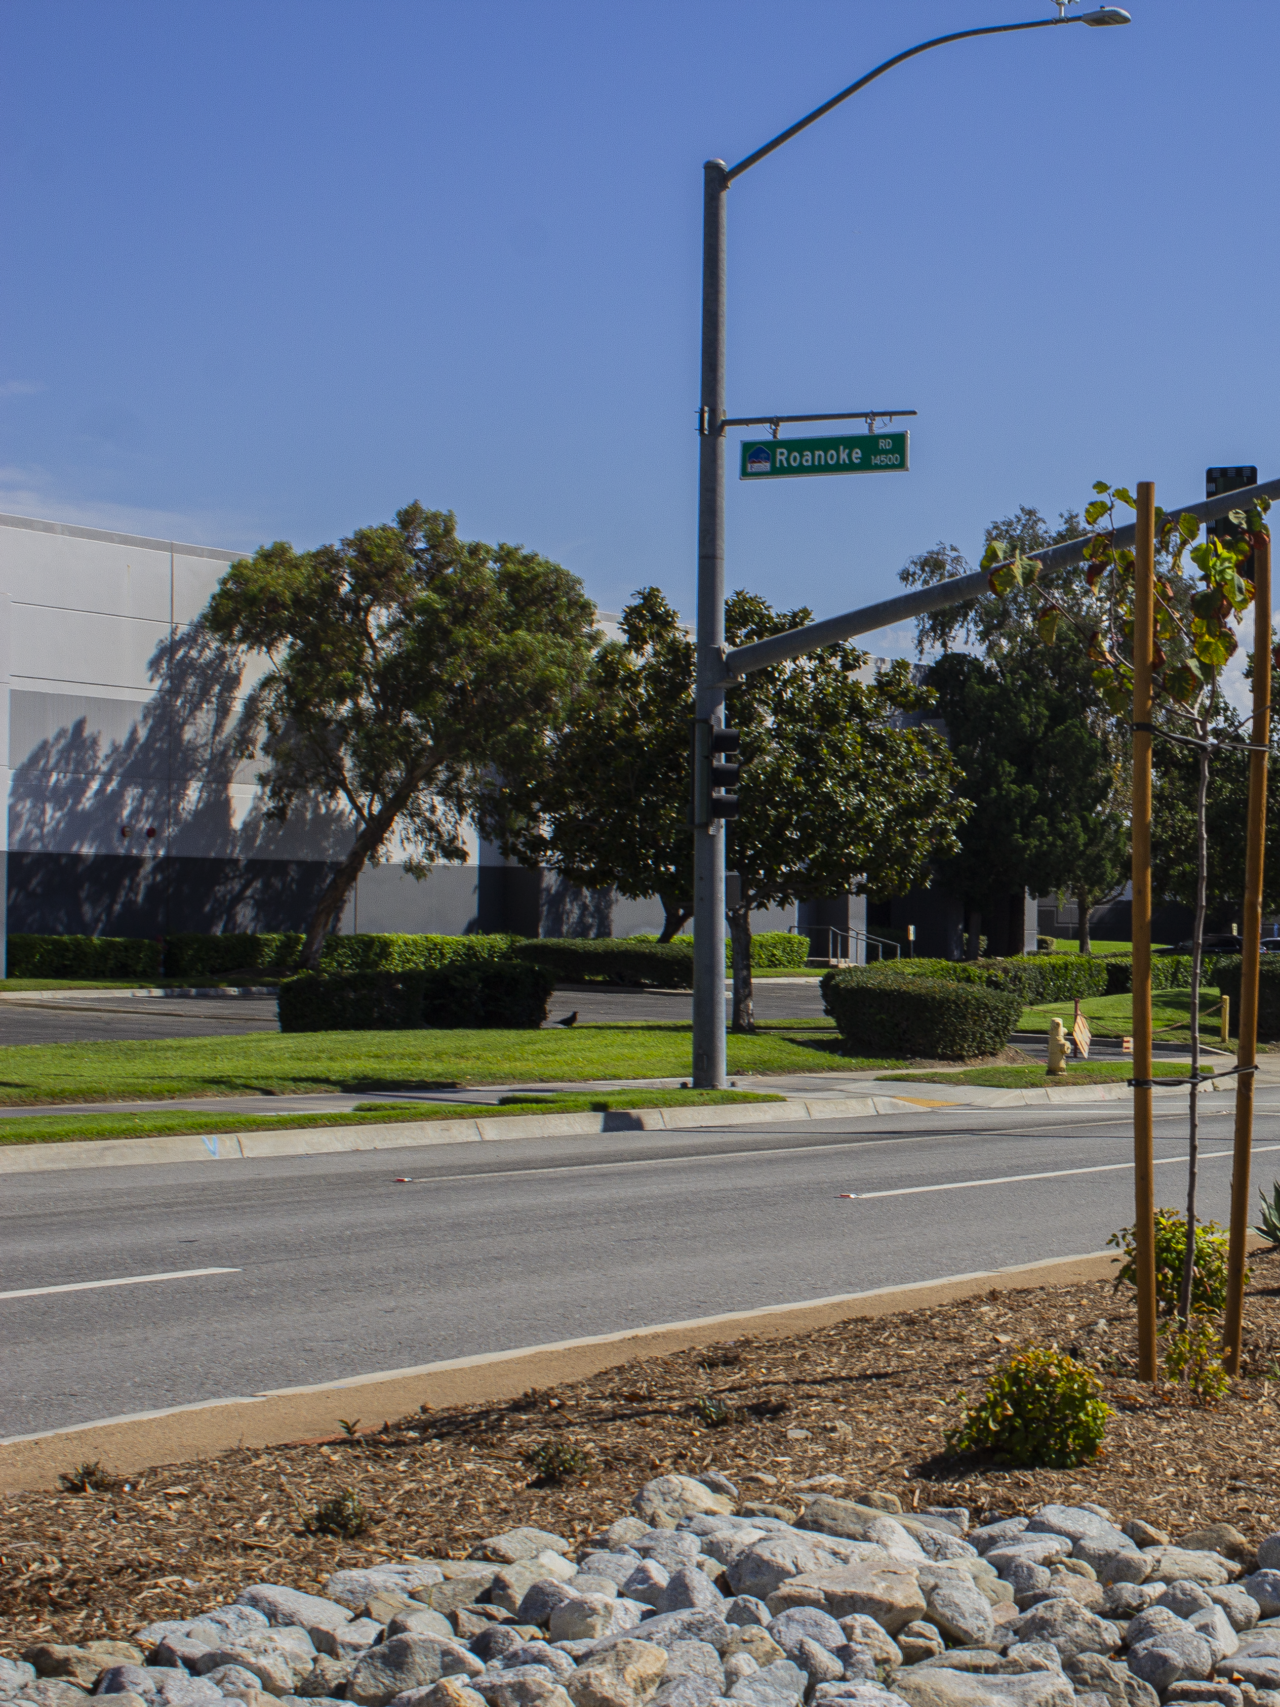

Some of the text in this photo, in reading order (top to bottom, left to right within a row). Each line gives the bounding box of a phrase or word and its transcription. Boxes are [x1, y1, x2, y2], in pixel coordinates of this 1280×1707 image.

[878, 439, 892, 450] RD
[775, 445, 862, 468] Roanoke
[871, 454, 900, 466] 14500
